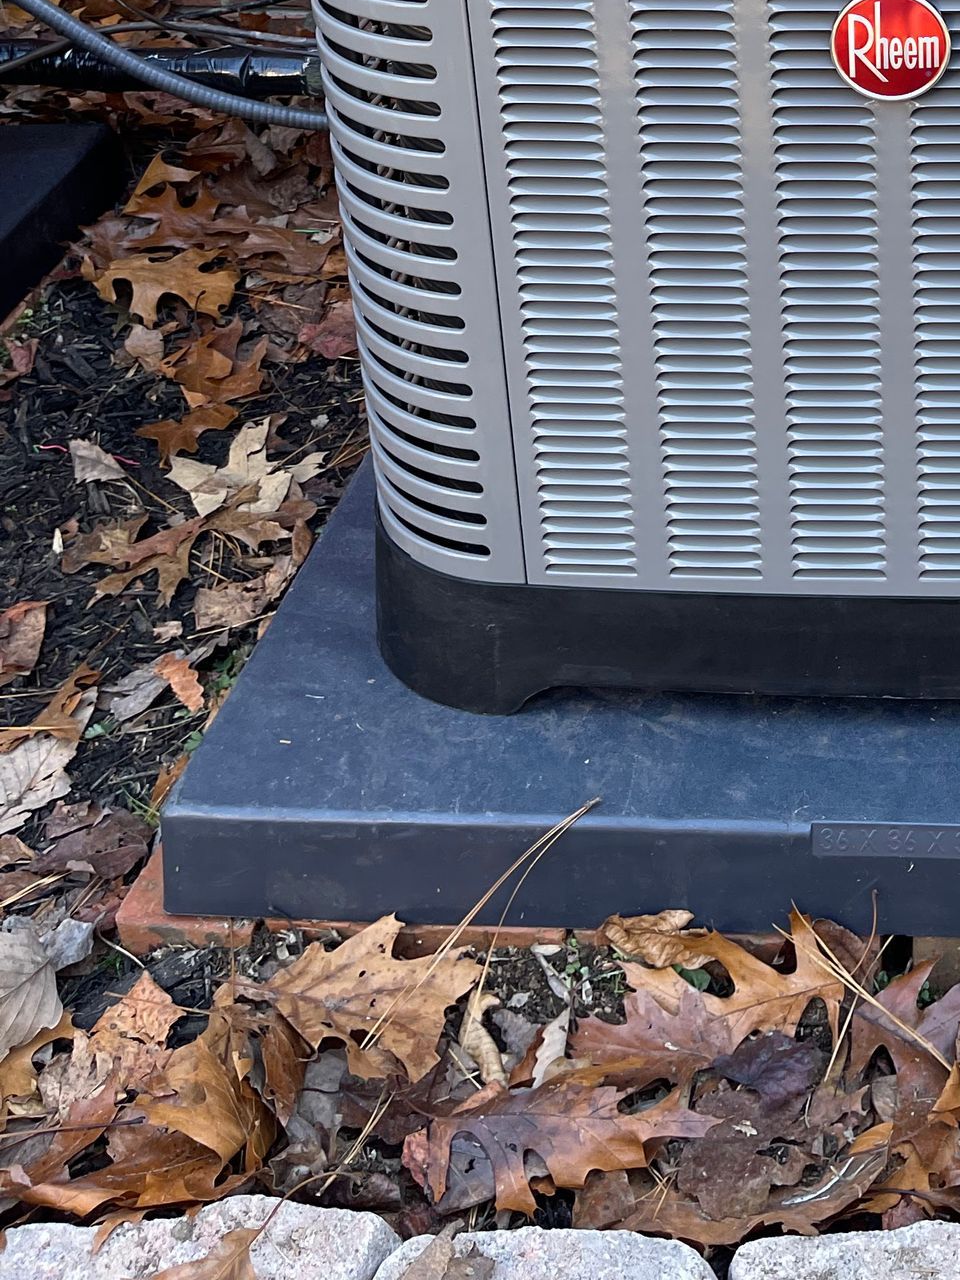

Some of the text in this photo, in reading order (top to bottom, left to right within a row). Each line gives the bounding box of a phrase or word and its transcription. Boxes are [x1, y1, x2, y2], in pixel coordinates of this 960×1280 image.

[847, 1, 940, 83] Rheem
[819, 827, 849, 851] 36
[887, 829, 917, 852] 36
